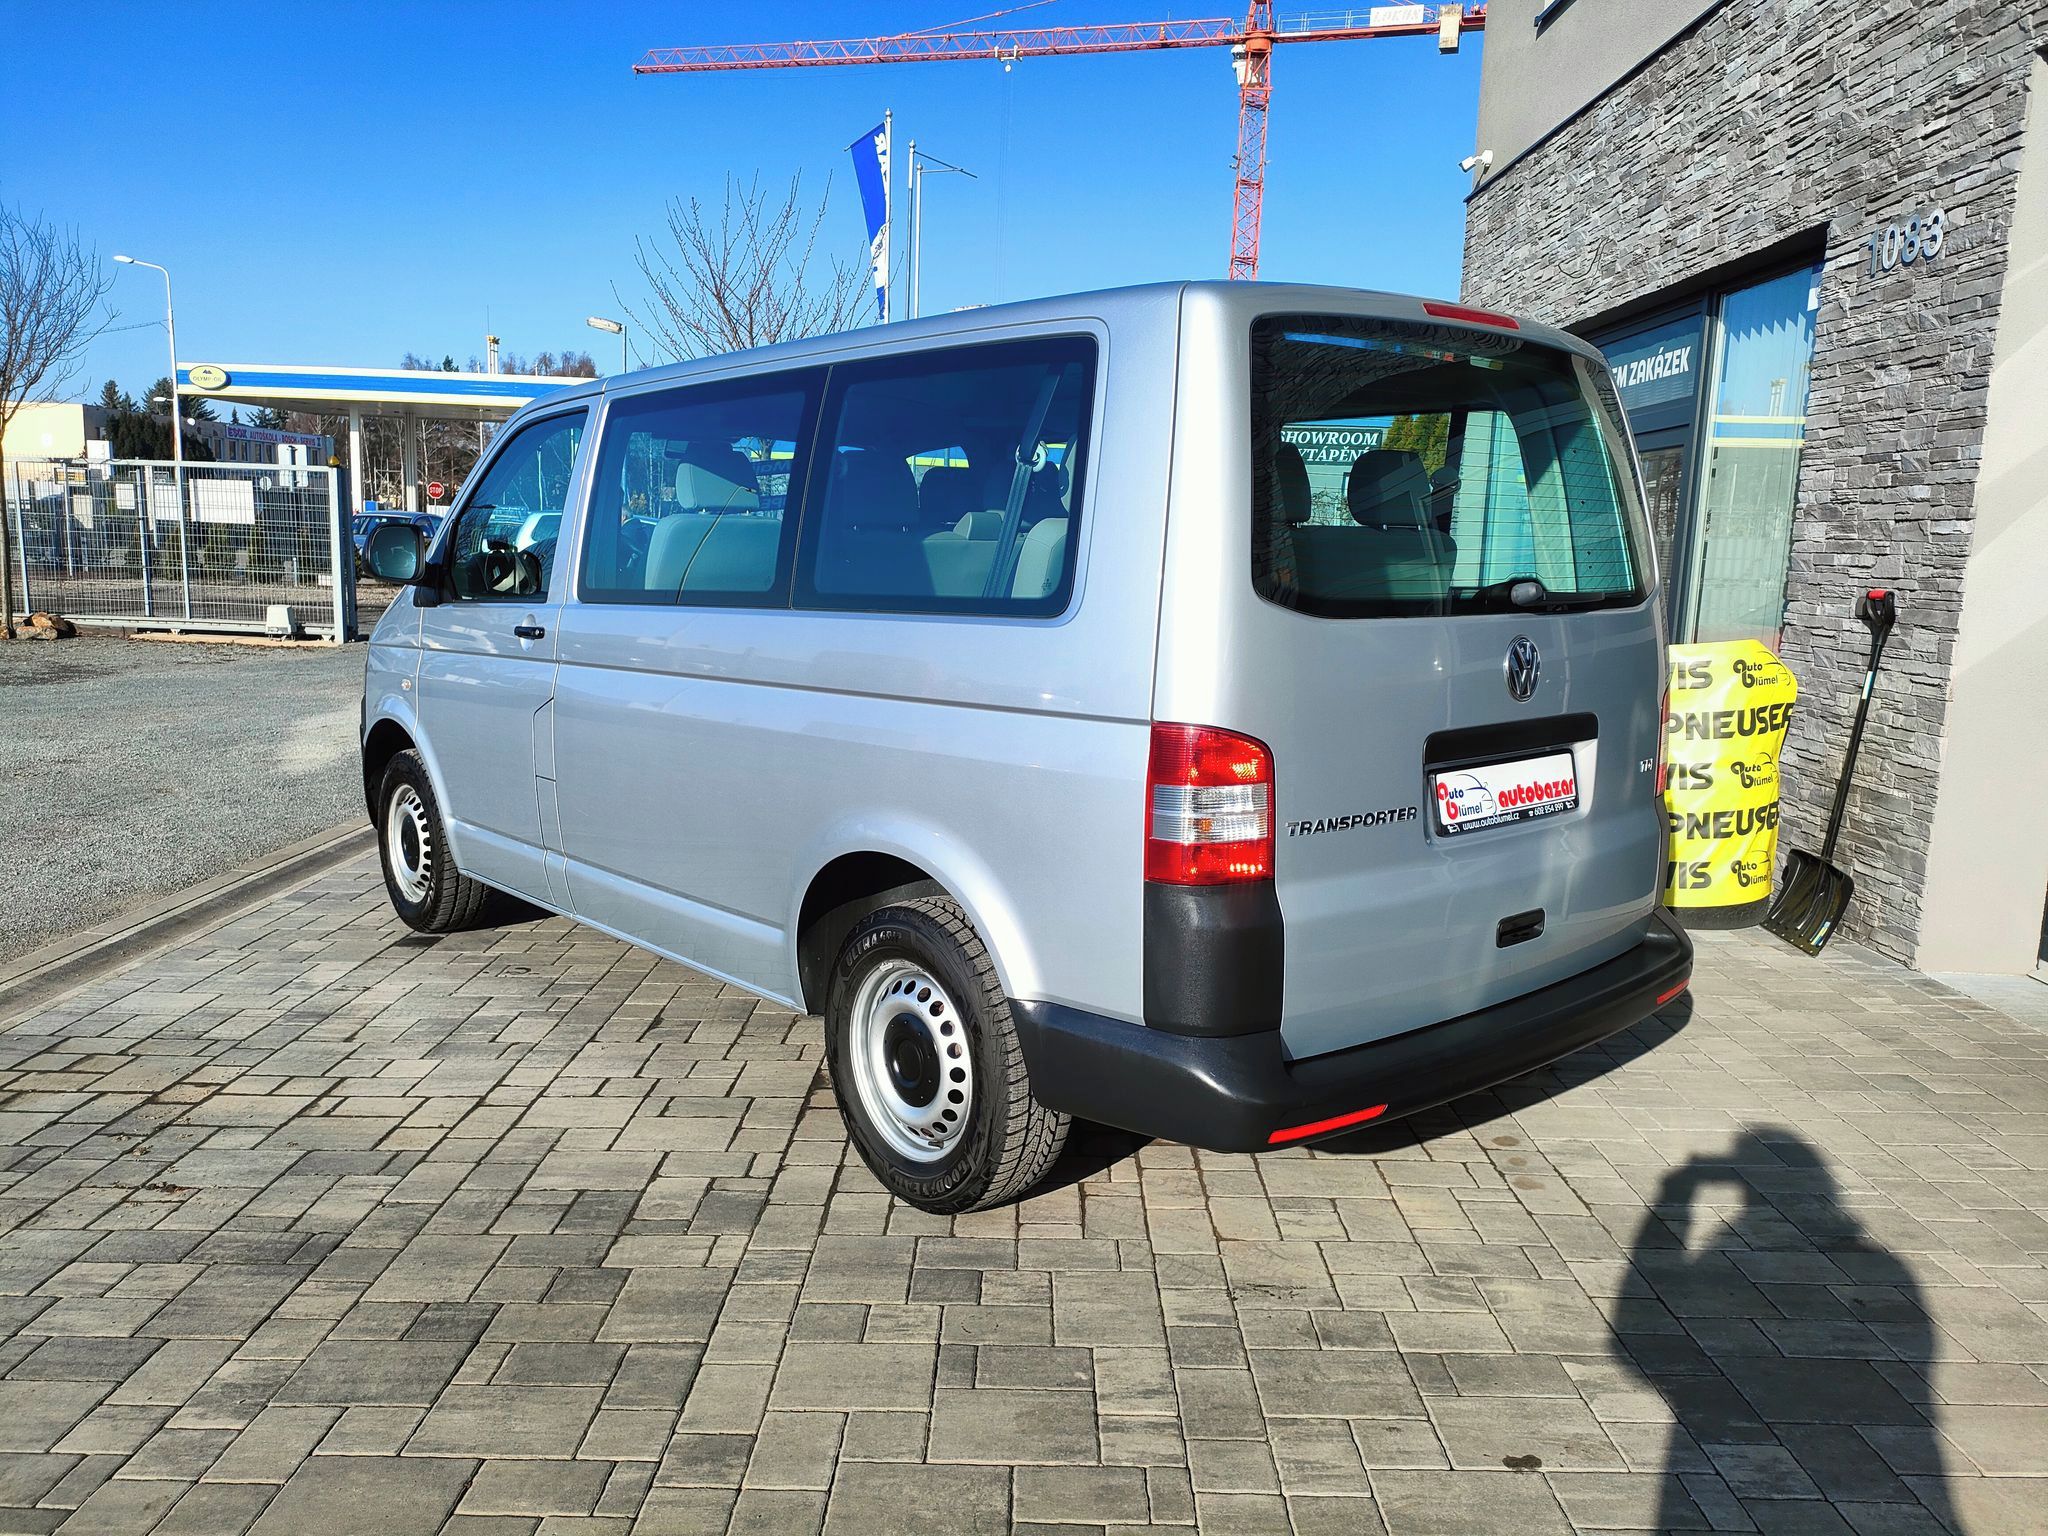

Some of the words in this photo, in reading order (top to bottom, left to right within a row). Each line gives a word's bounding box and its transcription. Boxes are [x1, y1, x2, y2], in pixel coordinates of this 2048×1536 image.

[1867, 206, 1945, 276] 1083
[1629, 347, 1691, 386] ZAKÁZEK
[1281, 431, 1379, 446] SHOWROOM
[430, 486, 442, 494] STOP
[1498, 778, 1574, 808] autobazar
[1286, 806, 1418, 837] TRANSPORTER
[845, 932, 878, 967] ULTRA
